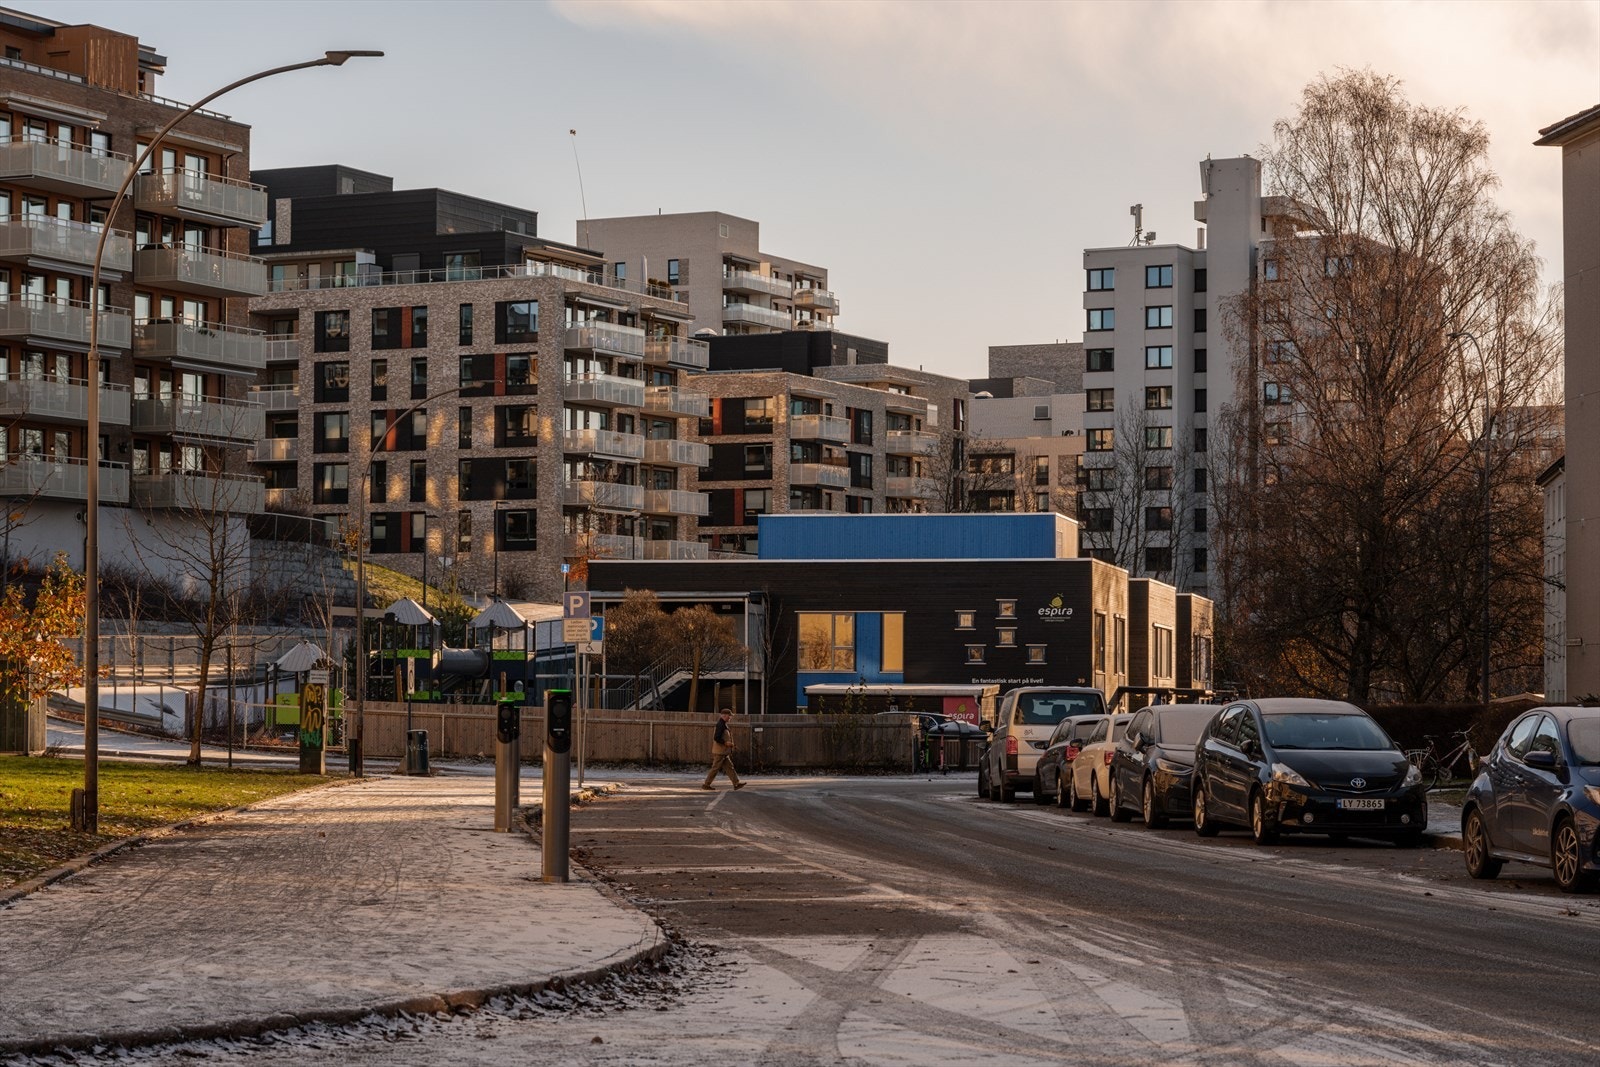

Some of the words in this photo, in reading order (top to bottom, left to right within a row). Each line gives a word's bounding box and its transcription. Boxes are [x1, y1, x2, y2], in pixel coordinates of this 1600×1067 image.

[570, 595, 584, 616] P
[1038, 608, 1073, 616] espira
[1356, 800, 1382, 808] 73865
